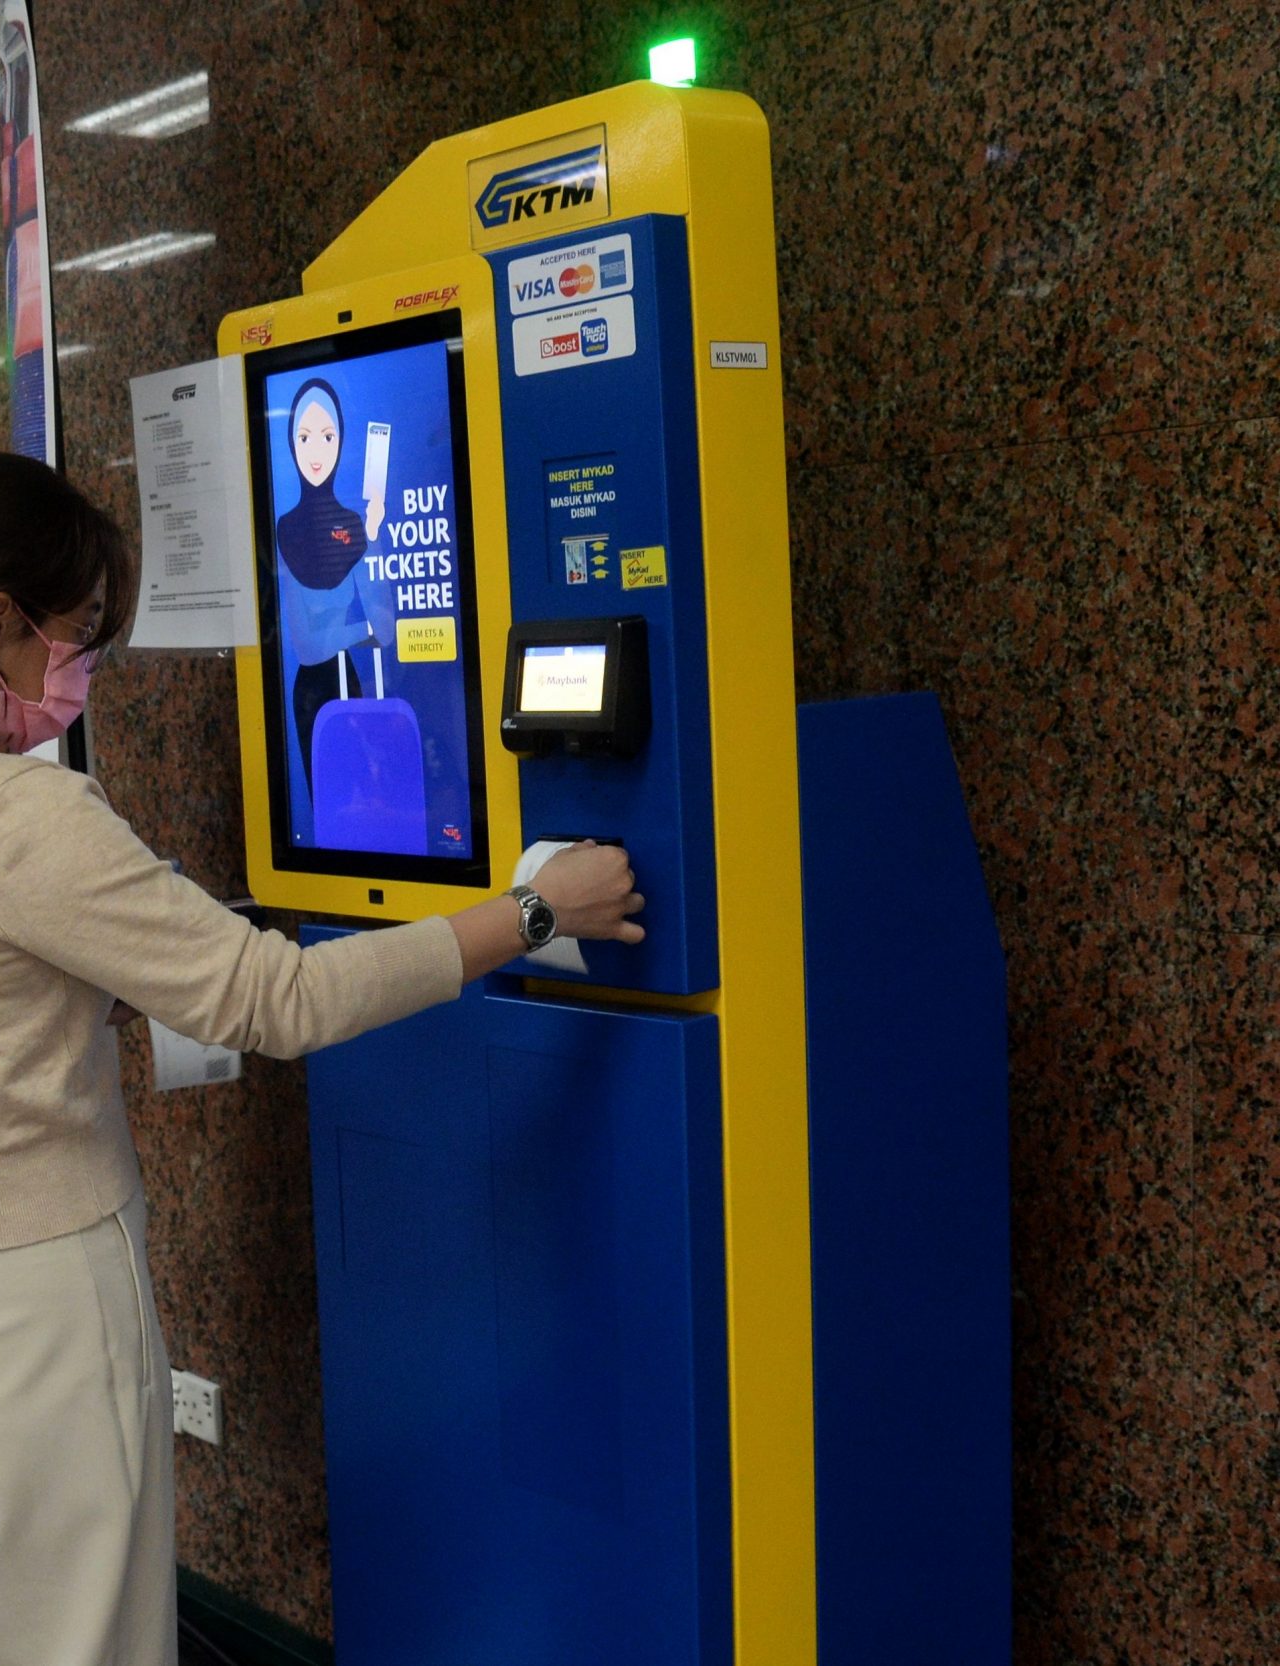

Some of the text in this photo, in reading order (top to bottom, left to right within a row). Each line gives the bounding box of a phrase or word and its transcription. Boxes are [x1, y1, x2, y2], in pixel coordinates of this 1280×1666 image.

[513, 176, 596, 222] KTM
[540, 246, 596, 266] ACCEPTED HERE
[513, 274, 594, 302] VISA MasterCard
[394, 285, 460, 309] POSIFLEX
[581, 323, 607, 336] Touch
[716, 352, 757, 363] KLSTVM01
[549, 464, 614, 483] INSERT MYKAD
[570, 480, 594, 493] HERE
[403, 485, 448, 514] BUY
[550, 490, 616, 508] MASUK MYKAD
[570, 506, 597, 519] DISINI
[387, 518, 451, 547] YOUR
[621, 551, 646, 560] INSERT
[365, 550, 452, 581] TICKETS
[628, 566, 649, 576] MyKad
[644, 574, 664, 584] HERE
[396, 582, 454, 611] HERE
[407, 627, 444, 639] KTM ETS &
[408, 643, 444, 653] INTERCITY
[546, 675, 588, 688] Maybank
